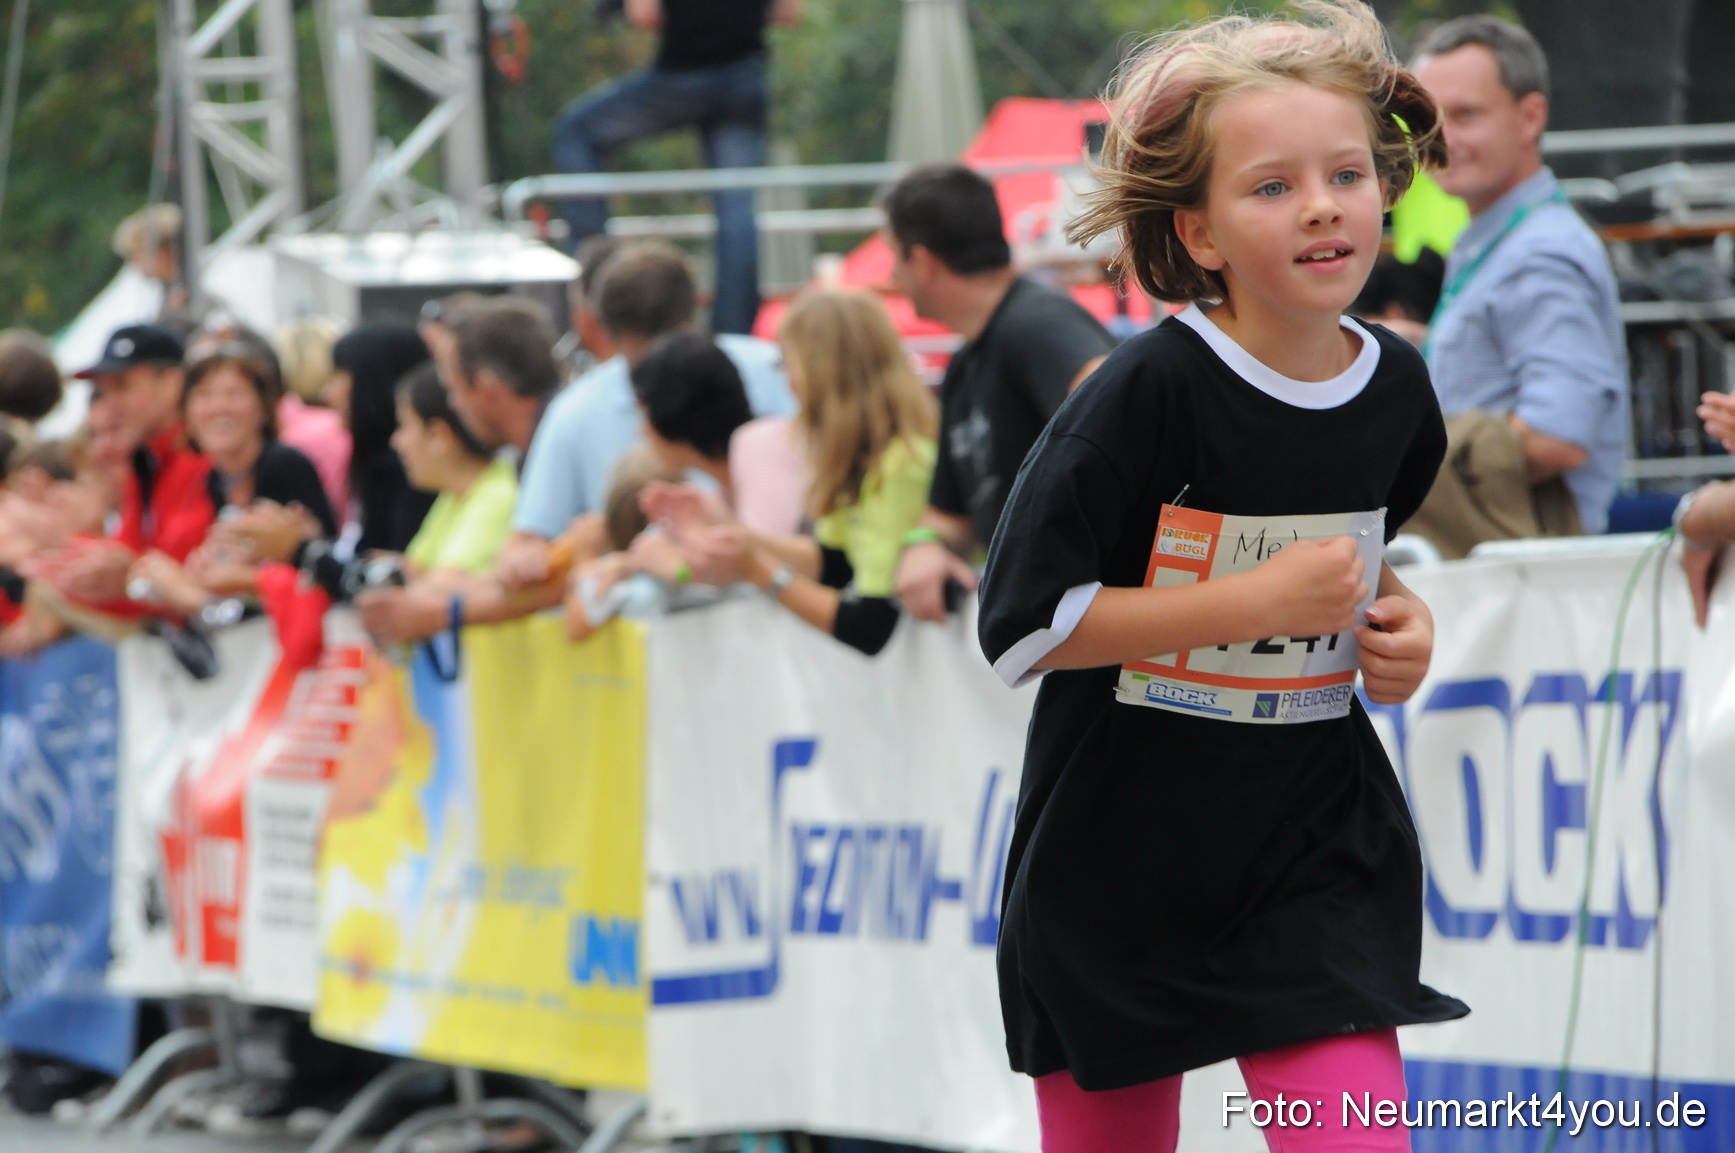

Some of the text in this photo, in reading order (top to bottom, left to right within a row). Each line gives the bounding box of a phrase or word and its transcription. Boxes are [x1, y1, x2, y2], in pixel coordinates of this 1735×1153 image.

[1175, 542, 1206, 556] BÖGL
[1145, 682, 1217, 706] BOCK
[1281, 685, 1351, 708] PFLEIDERER
[1356, 668, 1683, 950] OCK
